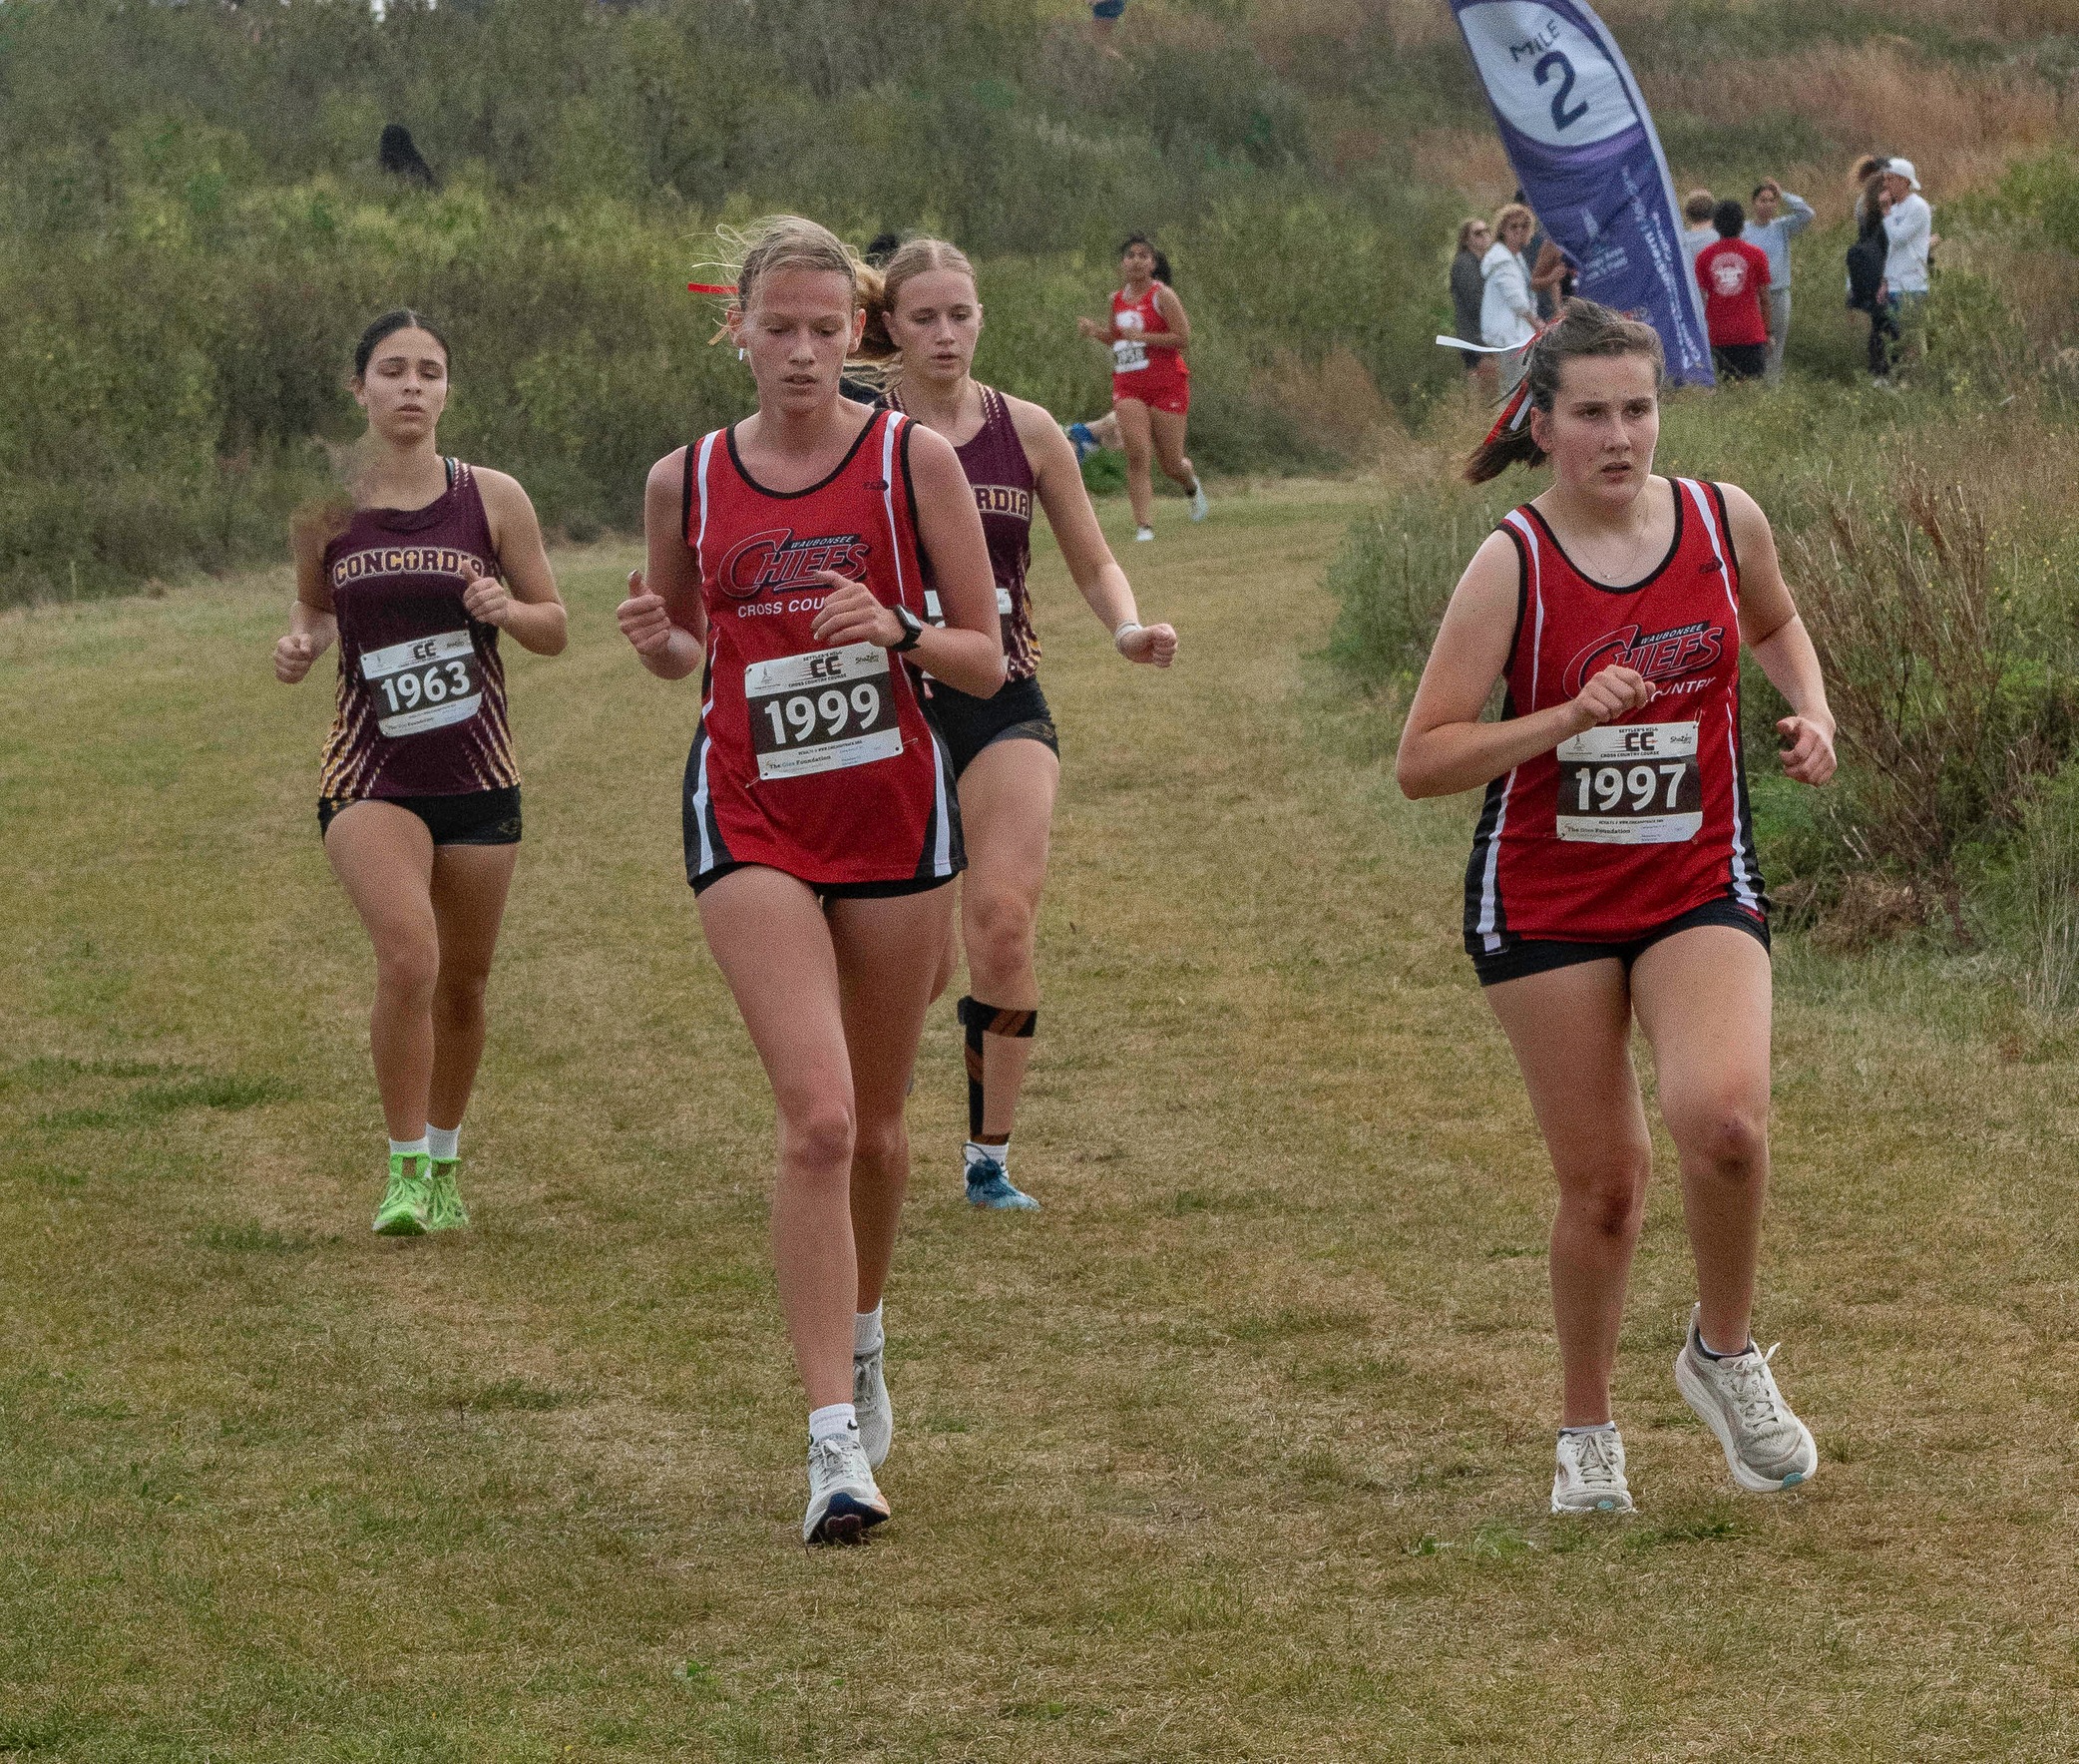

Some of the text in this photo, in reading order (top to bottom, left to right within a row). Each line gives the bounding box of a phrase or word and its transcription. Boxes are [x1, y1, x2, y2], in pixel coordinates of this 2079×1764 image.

[1508, 19, 1560, 62] MILE
[1533, 50, 1589, 132] 2
[790, 536, 853, 549] WAUBONSEE
[738, 602, 783, 619] CROSS
[1640, 624, 1704, 645] WAUBONSEE
[810, 656, 841, 677] CC
[381, 662, 470, 712] 1963
[764, 683, 880, 745] 1999
[1625, 731, 1655, 751] CC
[796, 755, 832, 765] Foundation
[1576, 763, 1686, 811] 1997
